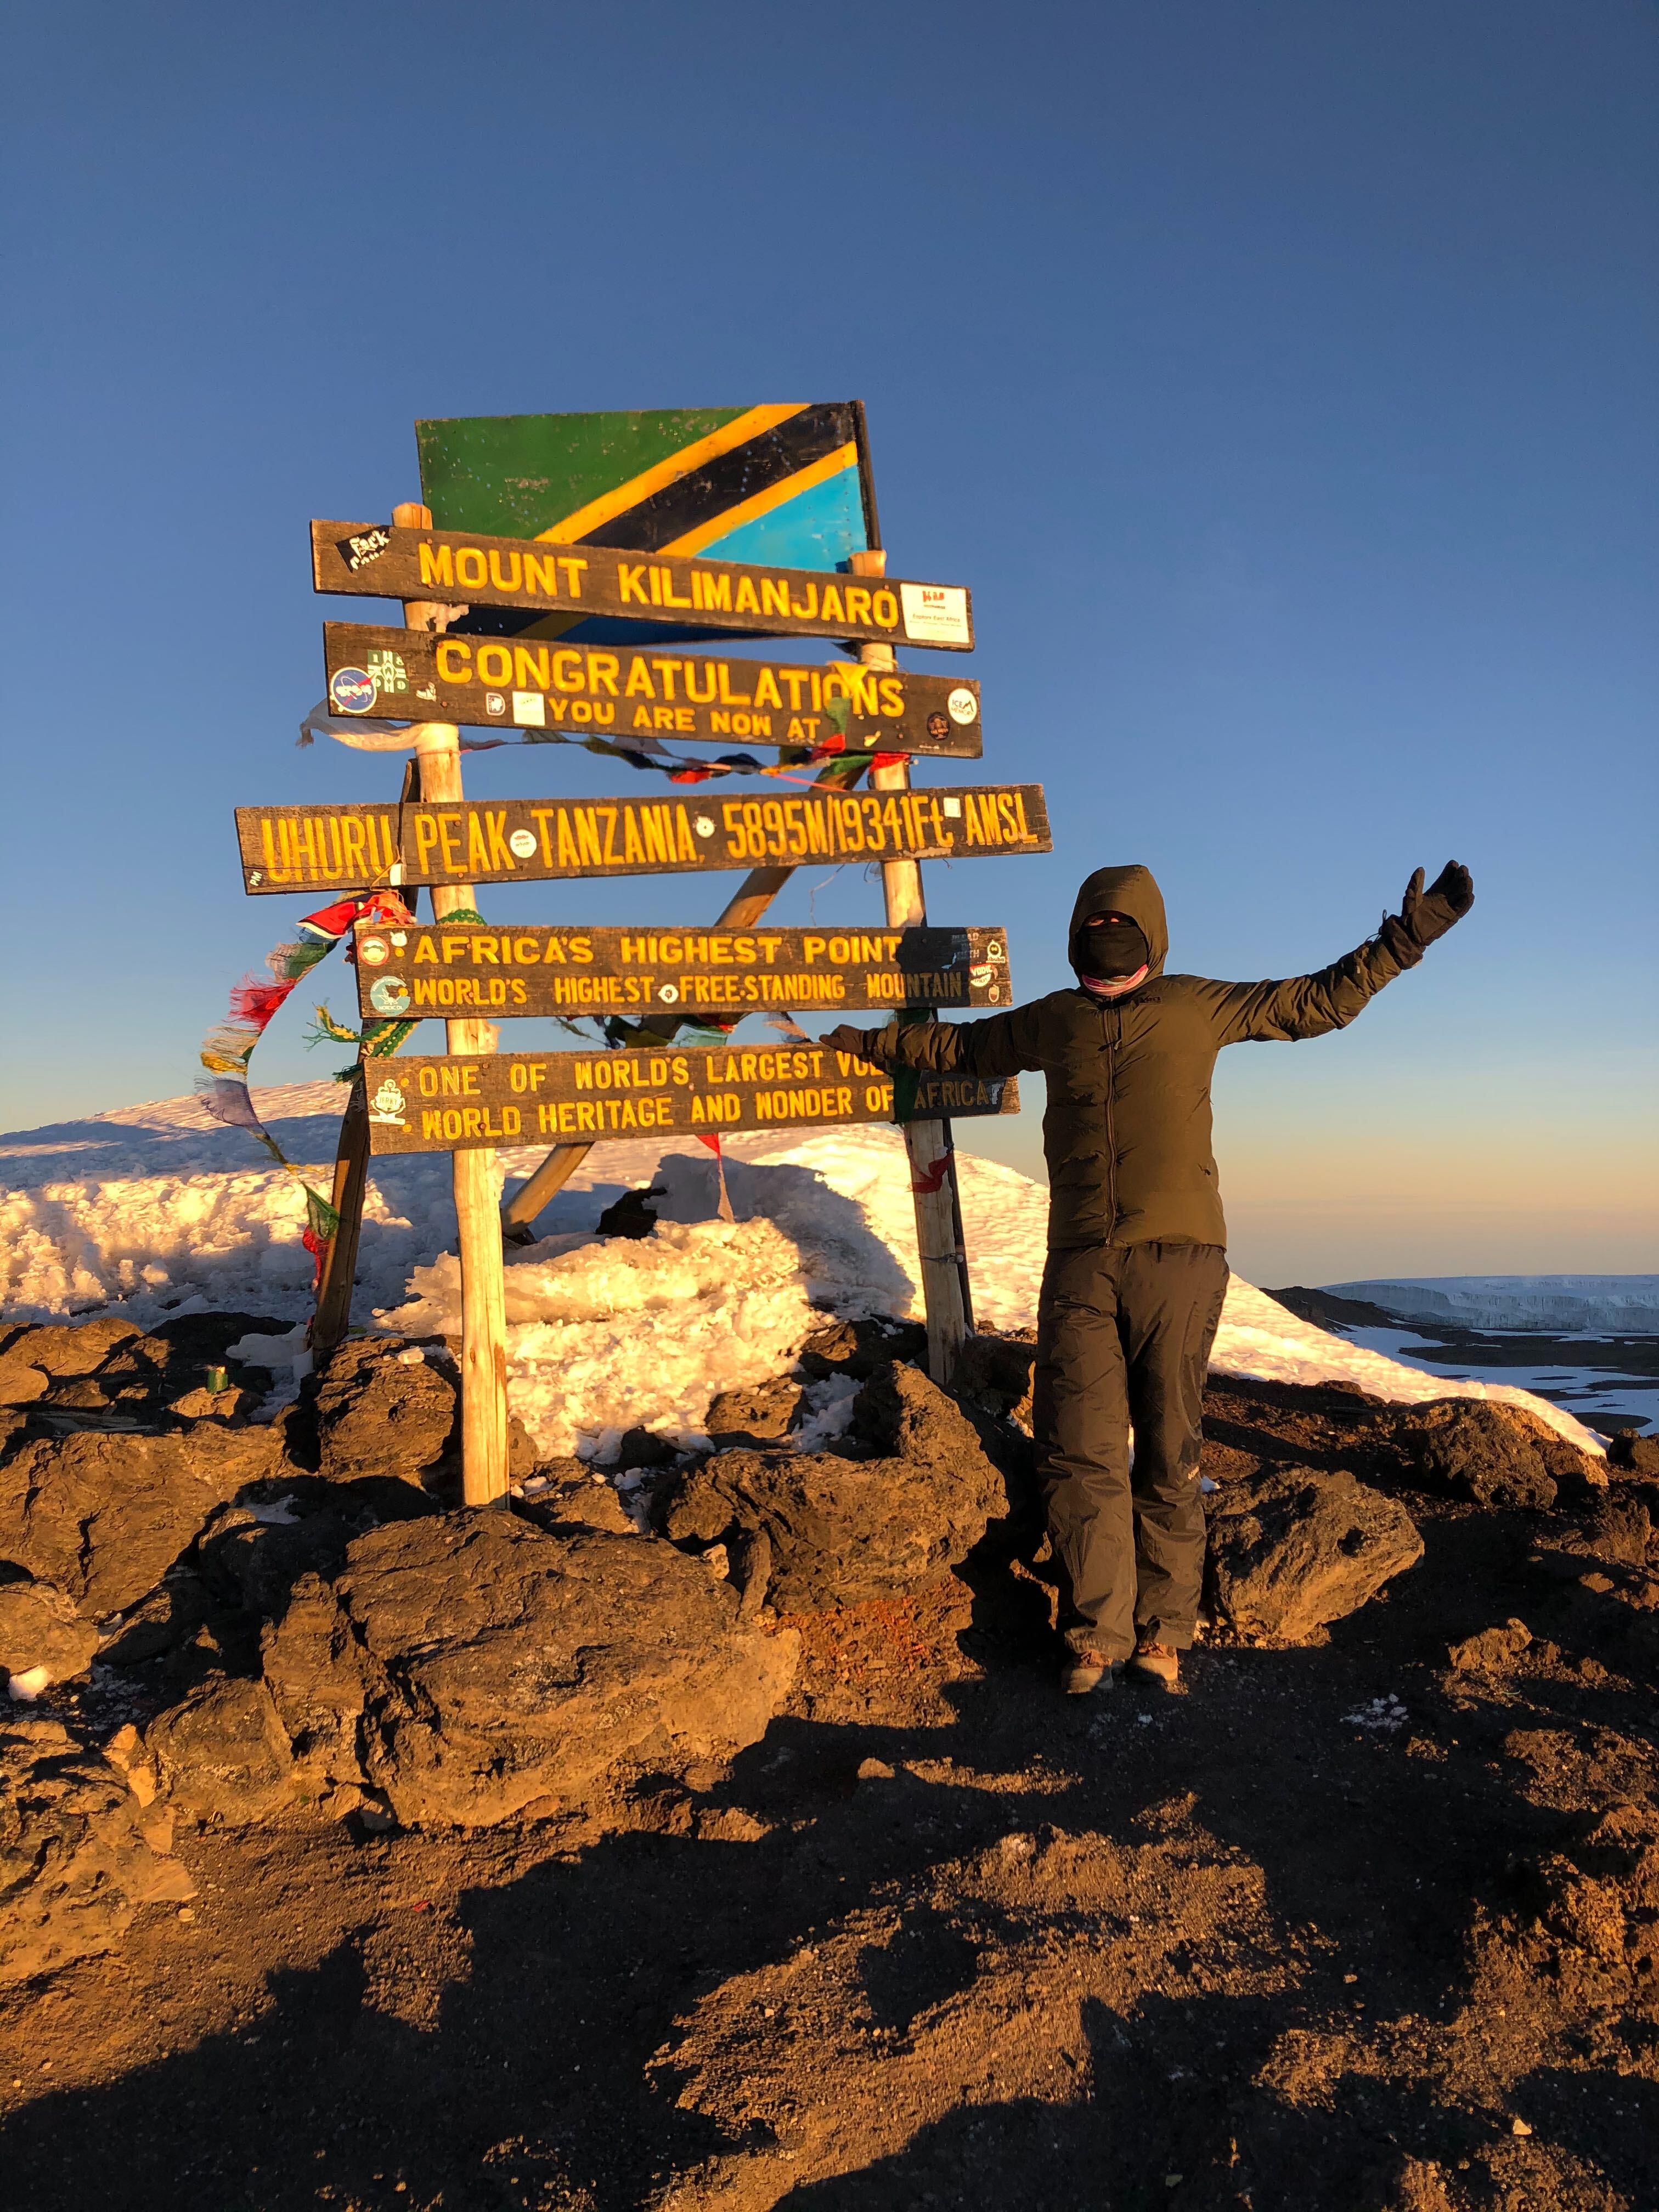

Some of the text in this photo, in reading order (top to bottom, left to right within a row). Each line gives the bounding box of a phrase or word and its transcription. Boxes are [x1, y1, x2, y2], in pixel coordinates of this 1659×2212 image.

[418, 543, 899, 629] MOUNT KILIMANJARO
[436, 640, 905, 718] CONGRATULATIONS
[548, 697, 821, 740] YOU ARE NOW AT
[261, 814, 395, 883] UHURU
[414, 810, 516, 876] PEAK
[964, 792, 1039, 846] AMSL
[249, 871, 263, 887] PM
[414, 935, 902, 965] AFRICA'S HIGHEST POINT
[414, 978, 527, 1005] WORLD'S
[554, 975, 655, 1005] HIGHEST
[866, 971, 962, 999] MOUNTAIN
[419, 1065, 481, 1097] ONE
[510, 1063, 548, 1093] OF
[574, 1056, 689, 1090] WORLD'S
[706, 1050, 823, 1084] LARGEST
[379, 1097, 398, 1105] JERKY
[421, 1079, 990, 1141] WORLD HERITAGE AND WONDER OF AFRICA
